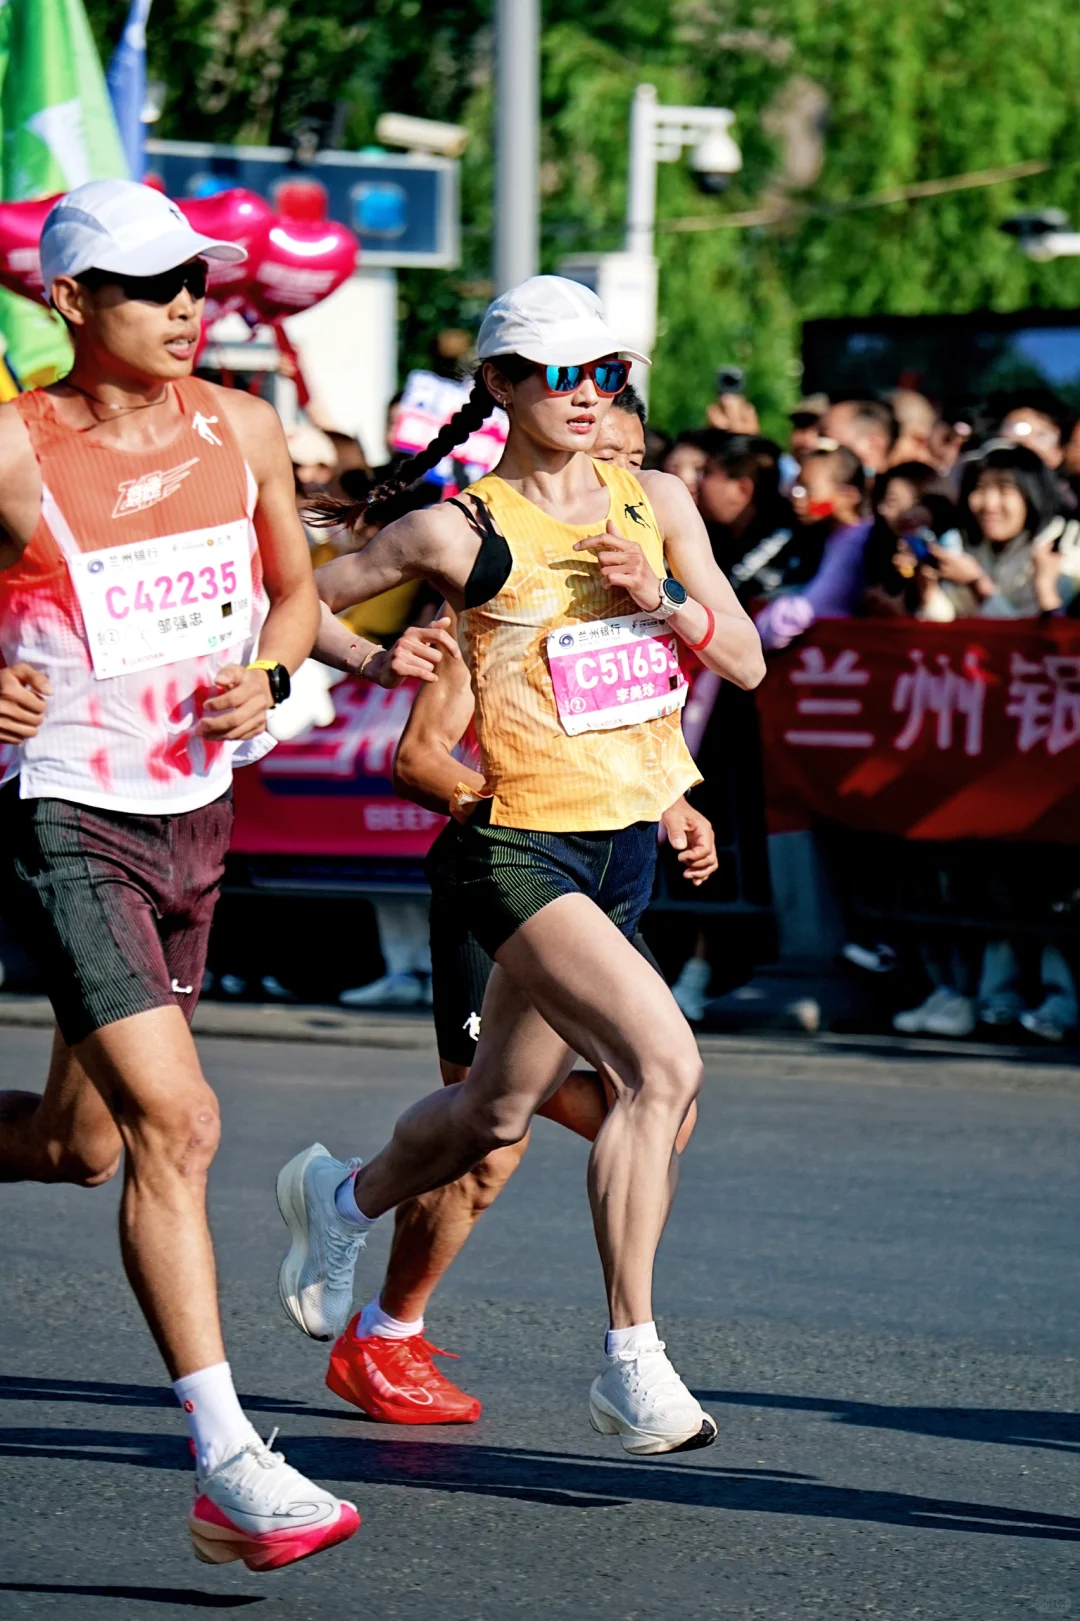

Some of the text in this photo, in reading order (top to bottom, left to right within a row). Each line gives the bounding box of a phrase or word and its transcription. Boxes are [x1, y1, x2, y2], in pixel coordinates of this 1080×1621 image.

[109, 548, 158, 567] 兰州银行
[105, 560, 237, 619] C42235
[158, 612, 202, 634] 邹强忠
[578, 623, 621, 641] 兰州银行
[575, 638, 679, 690] C51653
